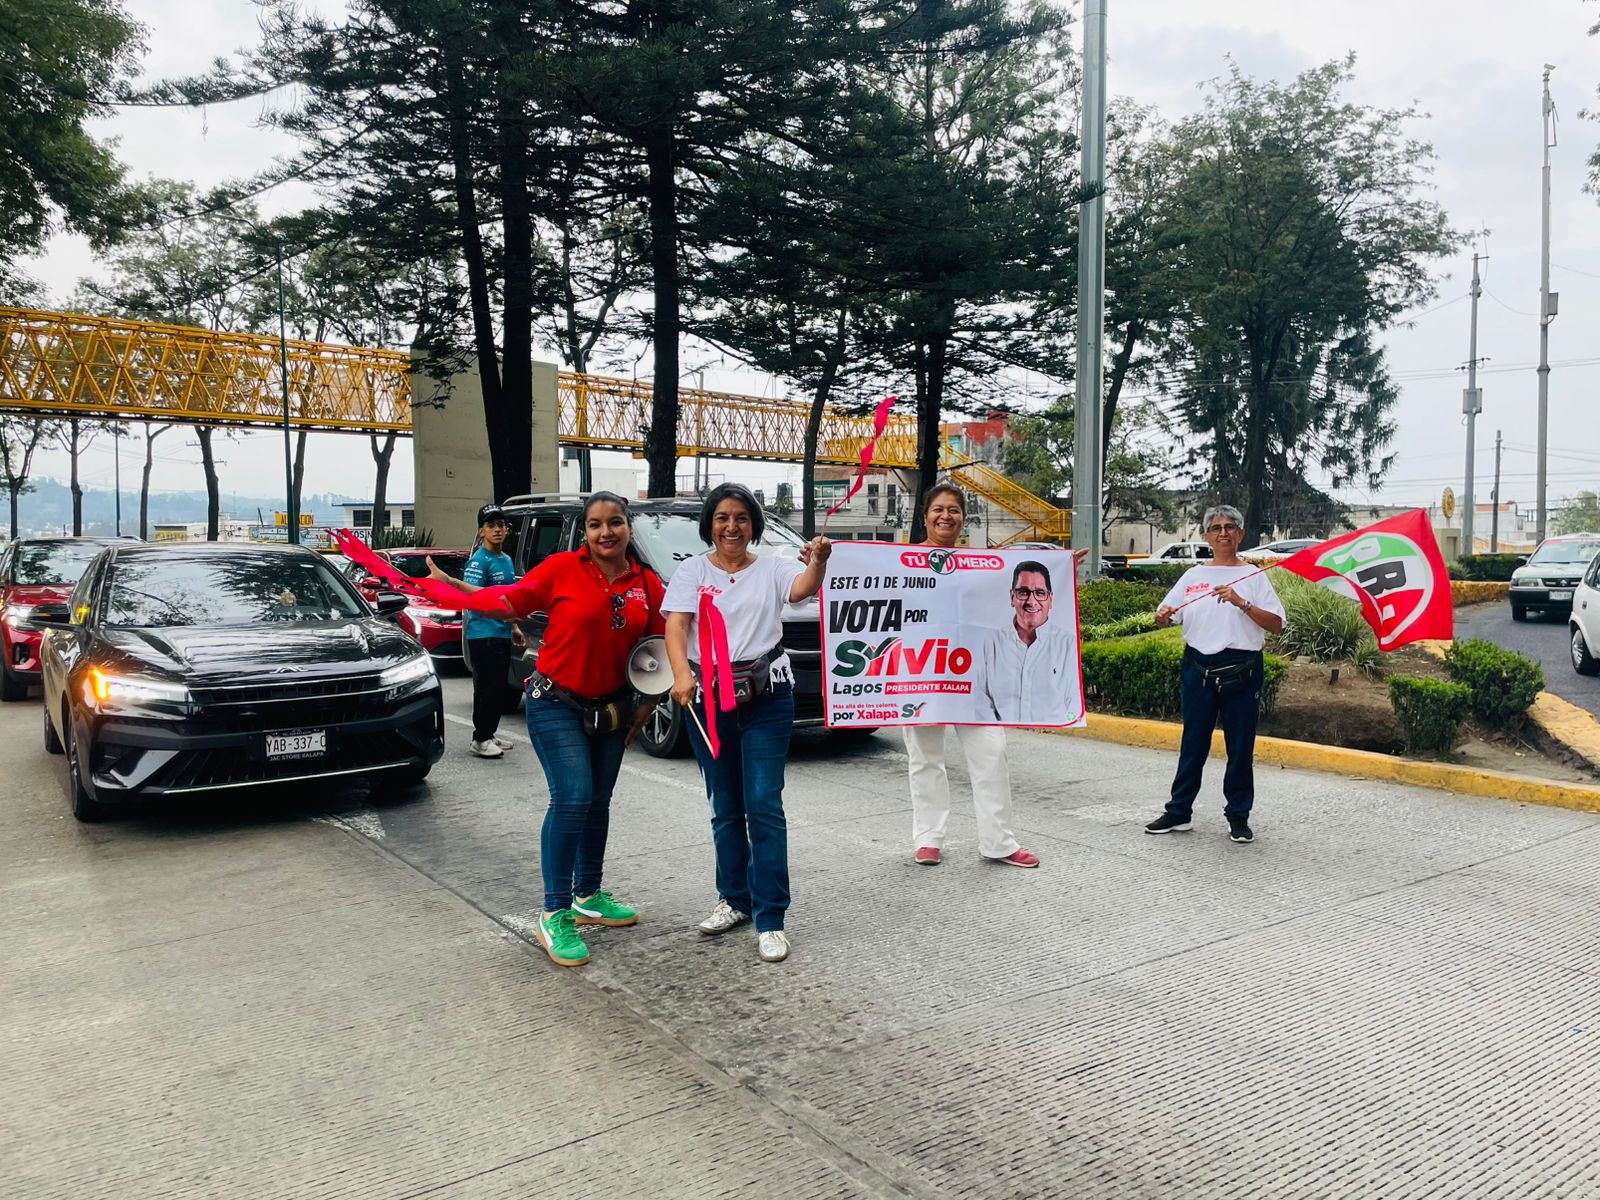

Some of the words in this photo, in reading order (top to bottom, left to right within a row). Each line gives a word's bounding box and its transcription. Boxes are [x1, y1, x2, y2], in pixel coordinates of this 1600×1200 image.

[905, 553, 926, 567] TÚ
[957, 557, 1000, 568] MERO
[830, 576, 859, 590] ESTE
[864, 576, 880, 588] 01
[884, 576, 898, 588] DE
[902, 577, 936, 588] JUNIO
[830, 599, 902, 633] VOTA
[904, 610, 928, 623] POR
[833, 682, 882, 696] Lagos
[886, 684, 940, 692] PRESIDENTE
[942, 684, 970, 692] XALAPA
[833, 712, 854, 722] por
[857, 710, 898, 720] Xalapa
